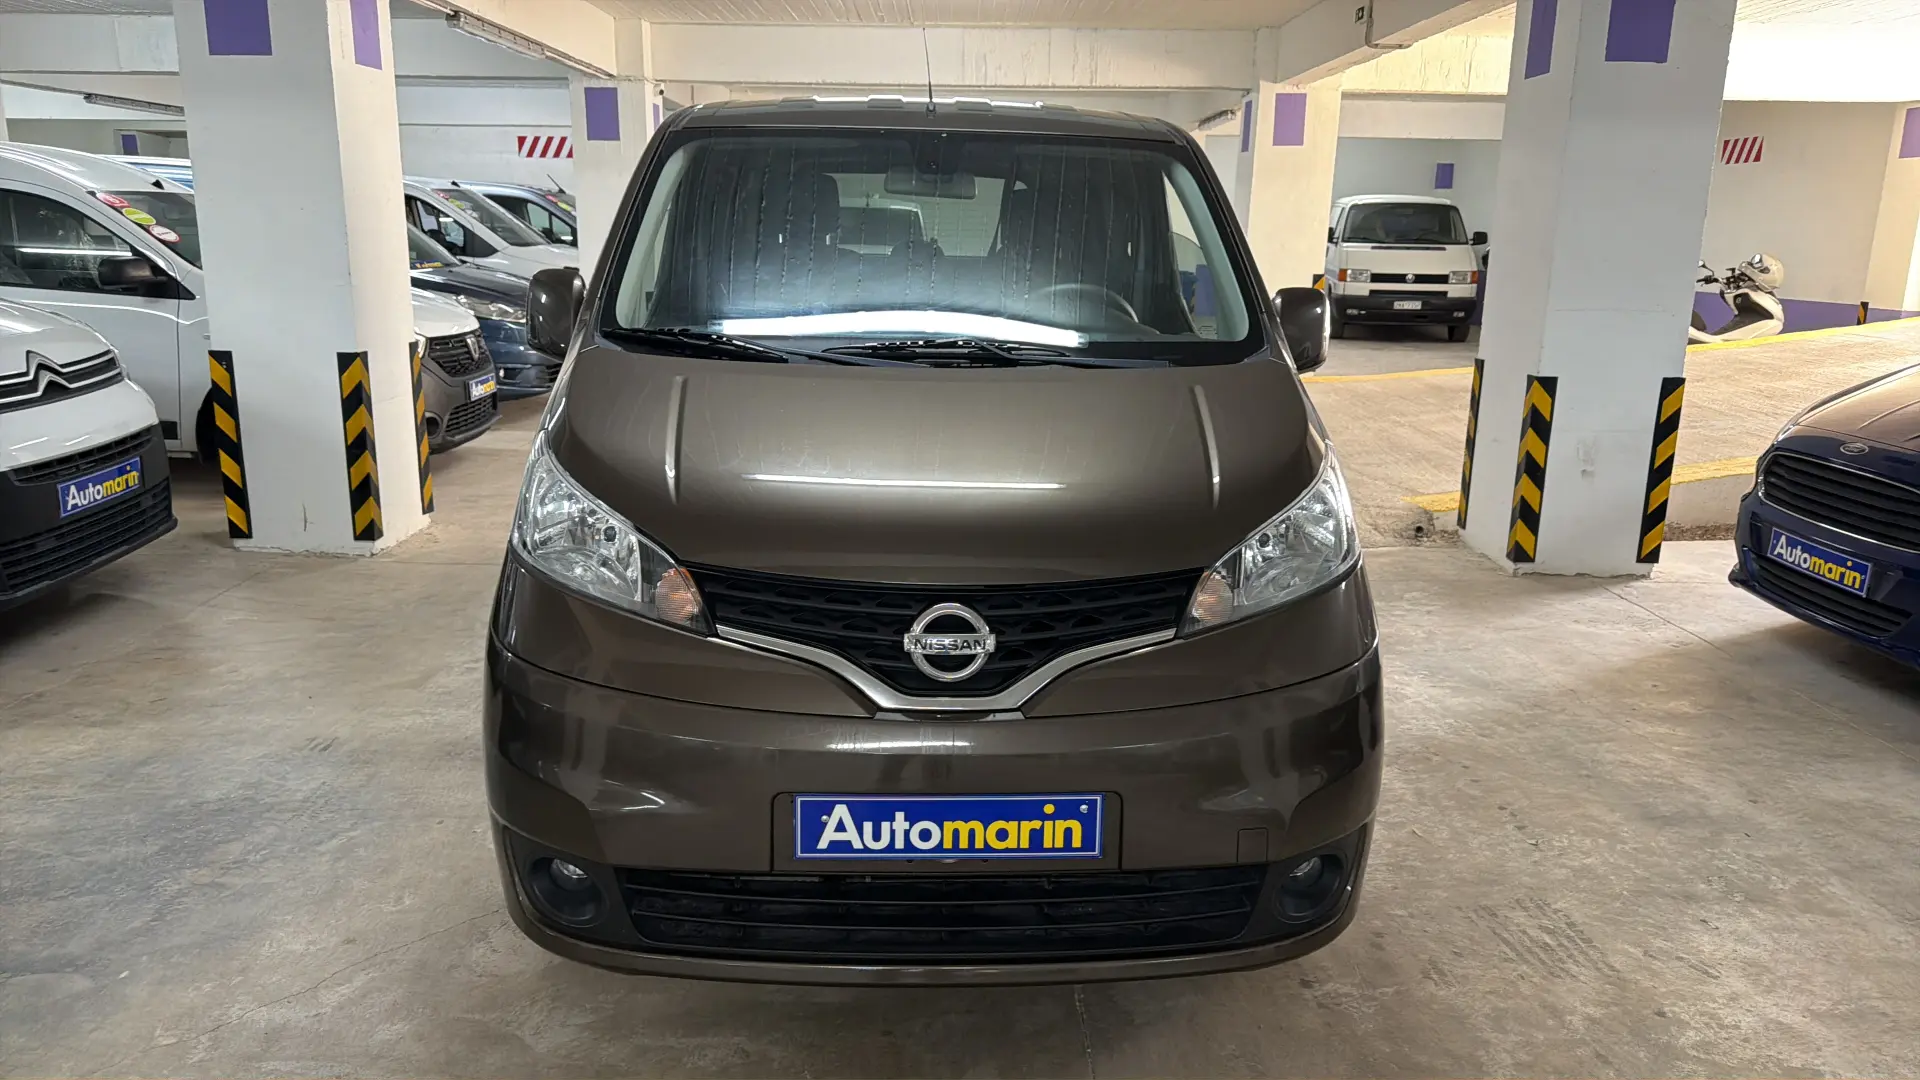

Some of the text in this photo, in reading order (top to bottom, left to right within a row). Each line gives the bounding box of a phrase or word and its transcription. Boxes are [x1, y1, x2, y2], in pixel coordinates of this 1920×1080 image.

[67, 465, 139, 511] Automarin
[1774, 535, 1861, 589] Automarin
[913, 637, 987, 652] NISSAN
[817, 803, 1082, 851] Automarin
